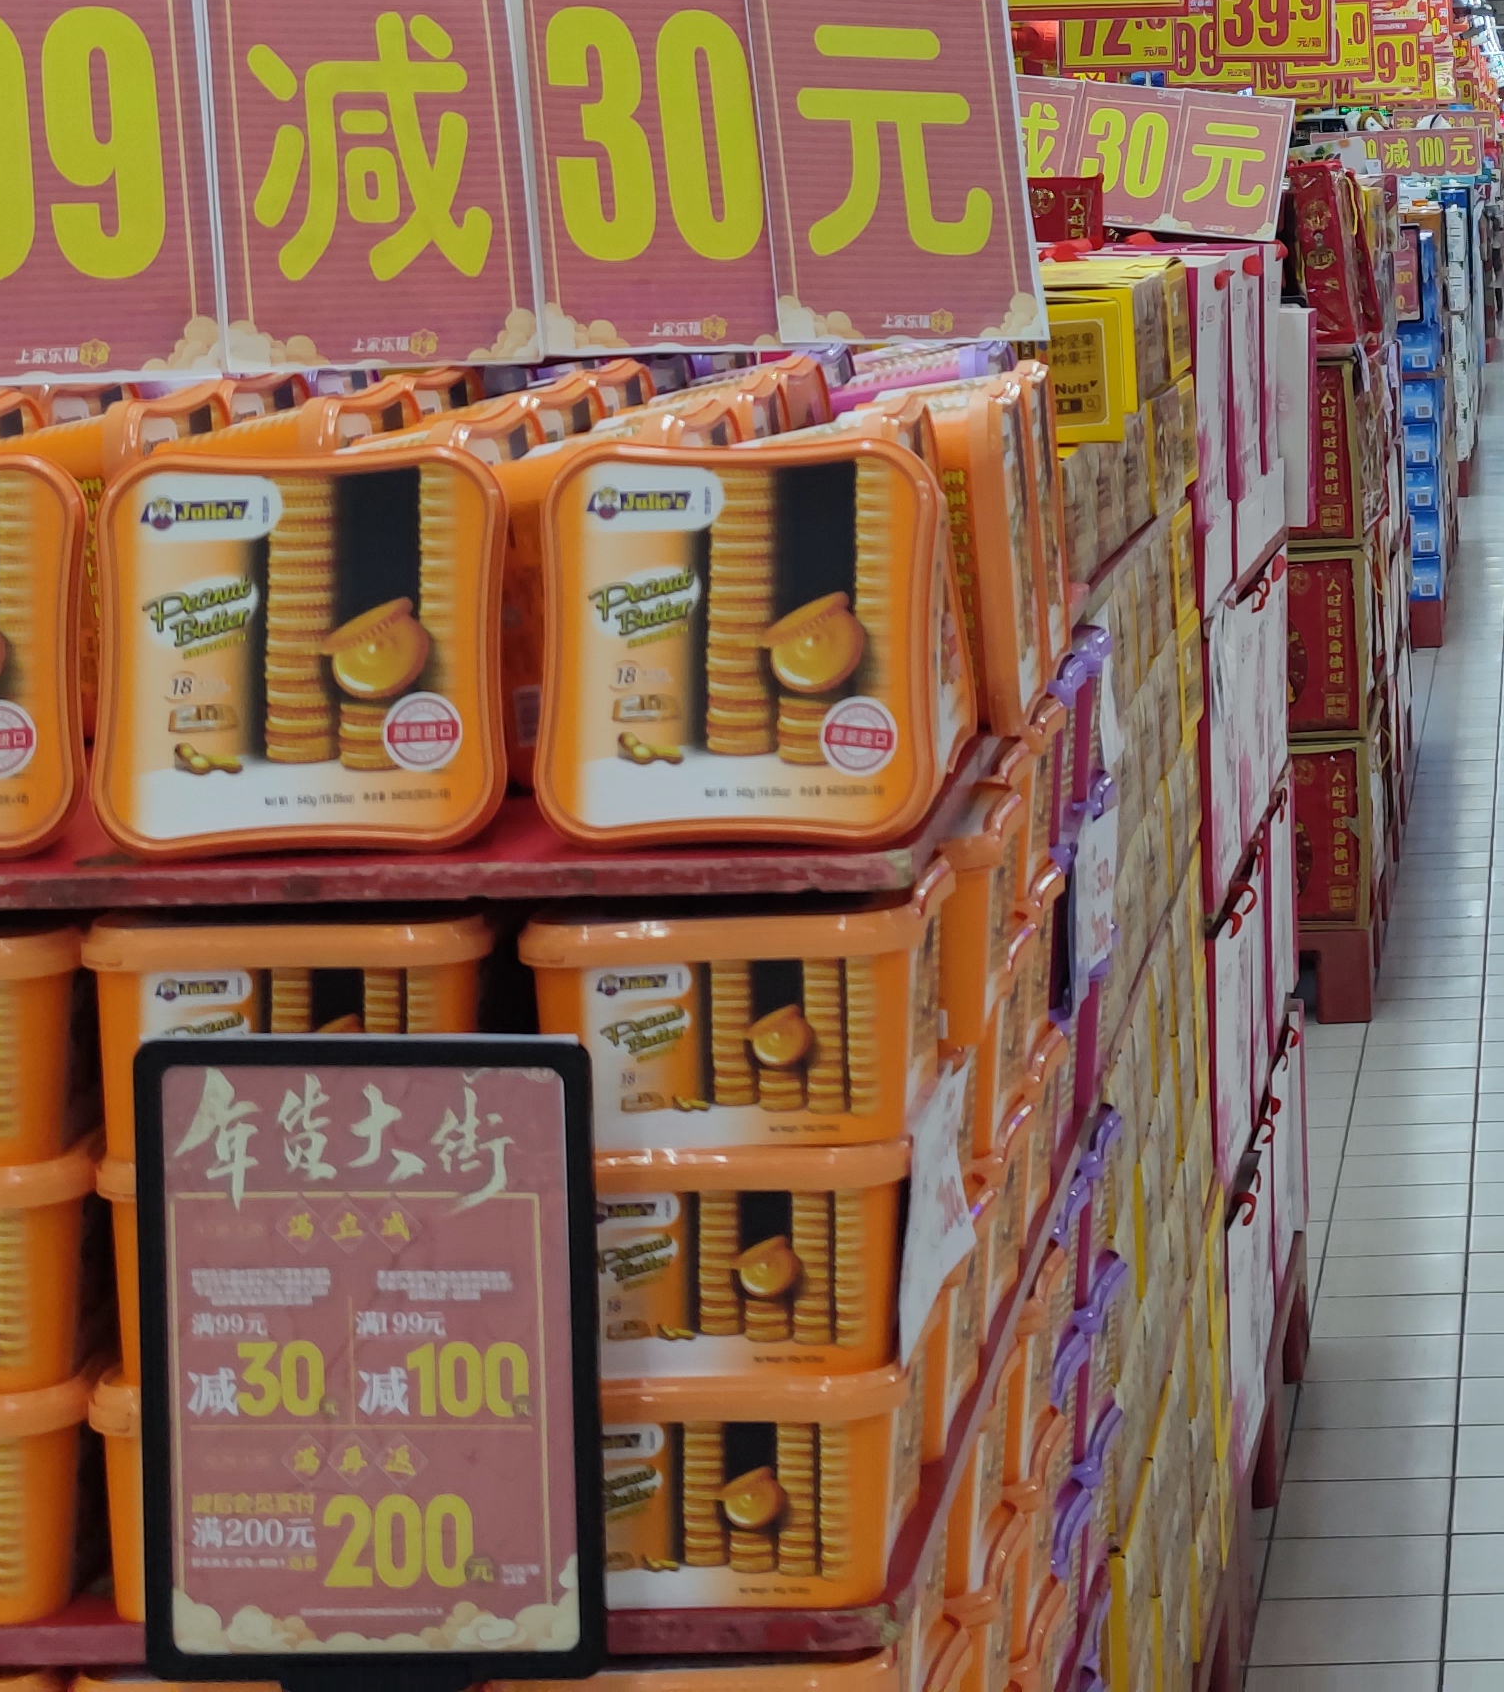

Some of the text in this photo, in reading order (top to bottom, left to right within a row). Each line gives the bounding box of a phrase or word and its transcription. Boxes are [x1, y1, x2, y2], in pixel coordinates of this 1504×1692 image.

[245, 10, 493, 282] 减
[545, 8, 765, 262] 30
[797, 24, 993, 259] 元
[1385, 137, 1475, 169] 减 100 元
[1182, 123, 1266, 207] 元
[1055, 382, 1090, 396] Nuts
[177, 502, 243, 521] Julie's
[622, 493, 686, 511] Julie's
[142, 576, 252, 633] Peanut
[589, 566, 694, 622] Peanut
[172, 610, 250, 649] Butter
[616, 599, 694, 636] Butter
[175, 1068, 516, 1215] 年货大街
[191, 1311, 269, 1337] 满99元
[356, 1310, 447, 1337] 满199元
[192, 1517, 318, 1549] 满200元
